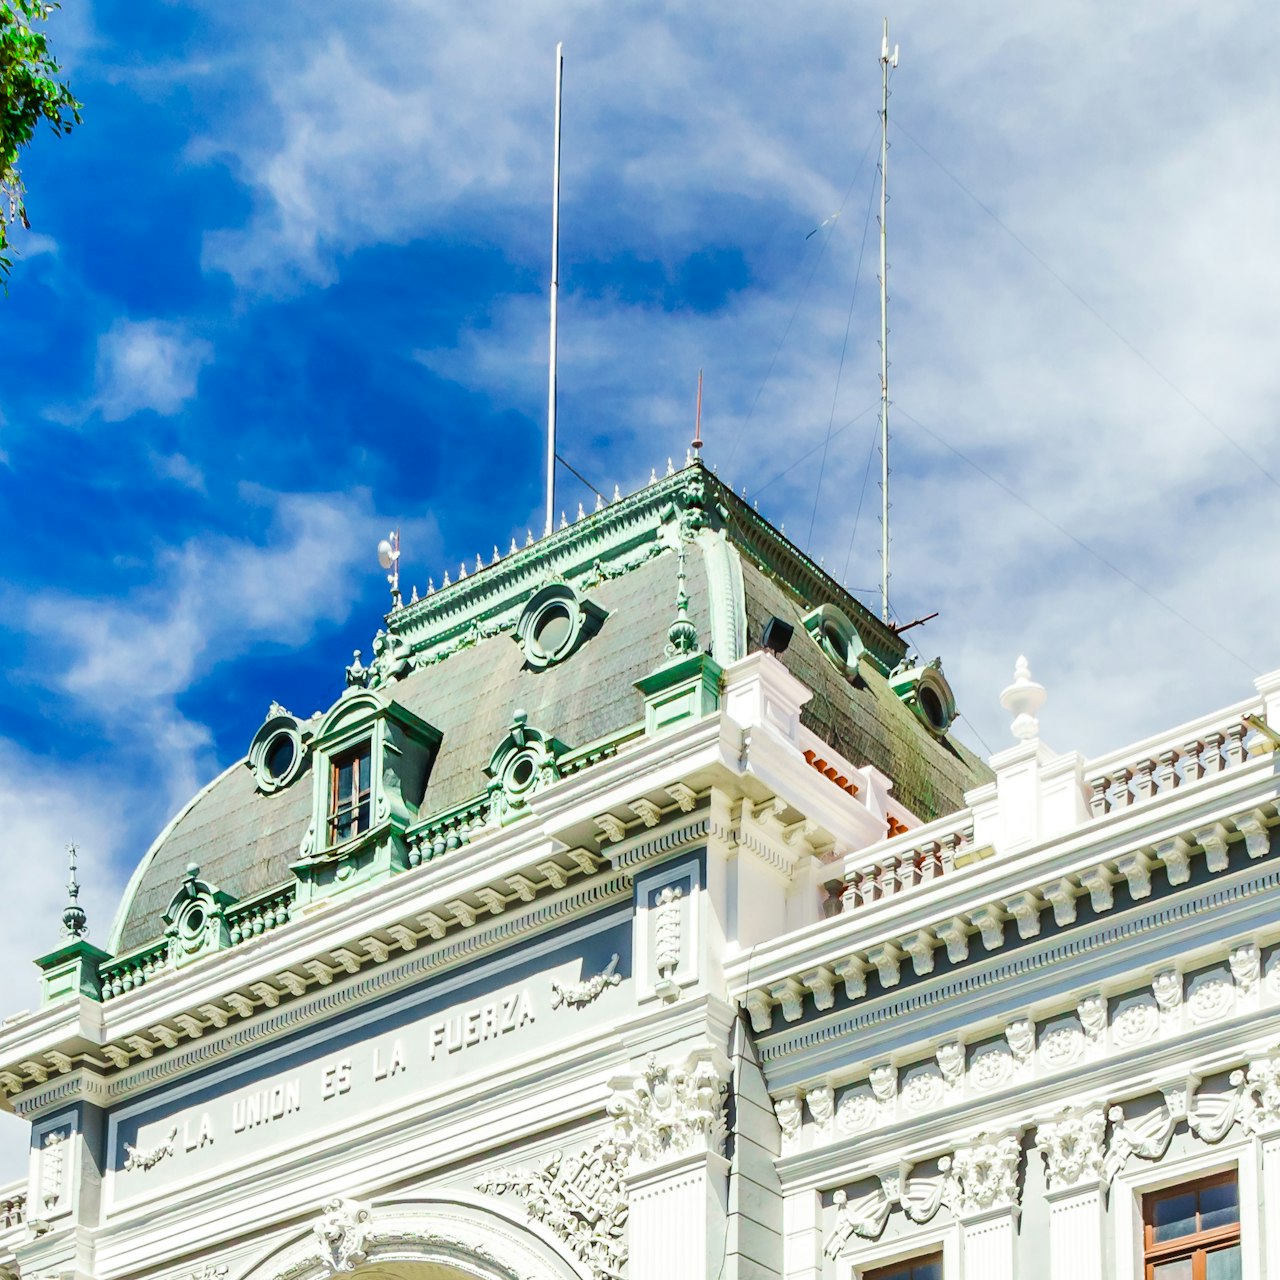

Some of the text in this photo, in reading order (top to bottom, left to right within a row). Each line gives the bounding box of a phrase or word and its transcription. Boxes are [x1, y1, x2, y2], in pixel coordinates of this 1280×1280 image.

[183, 988, 536, 1152] LA UNION ES LA FUERZA
